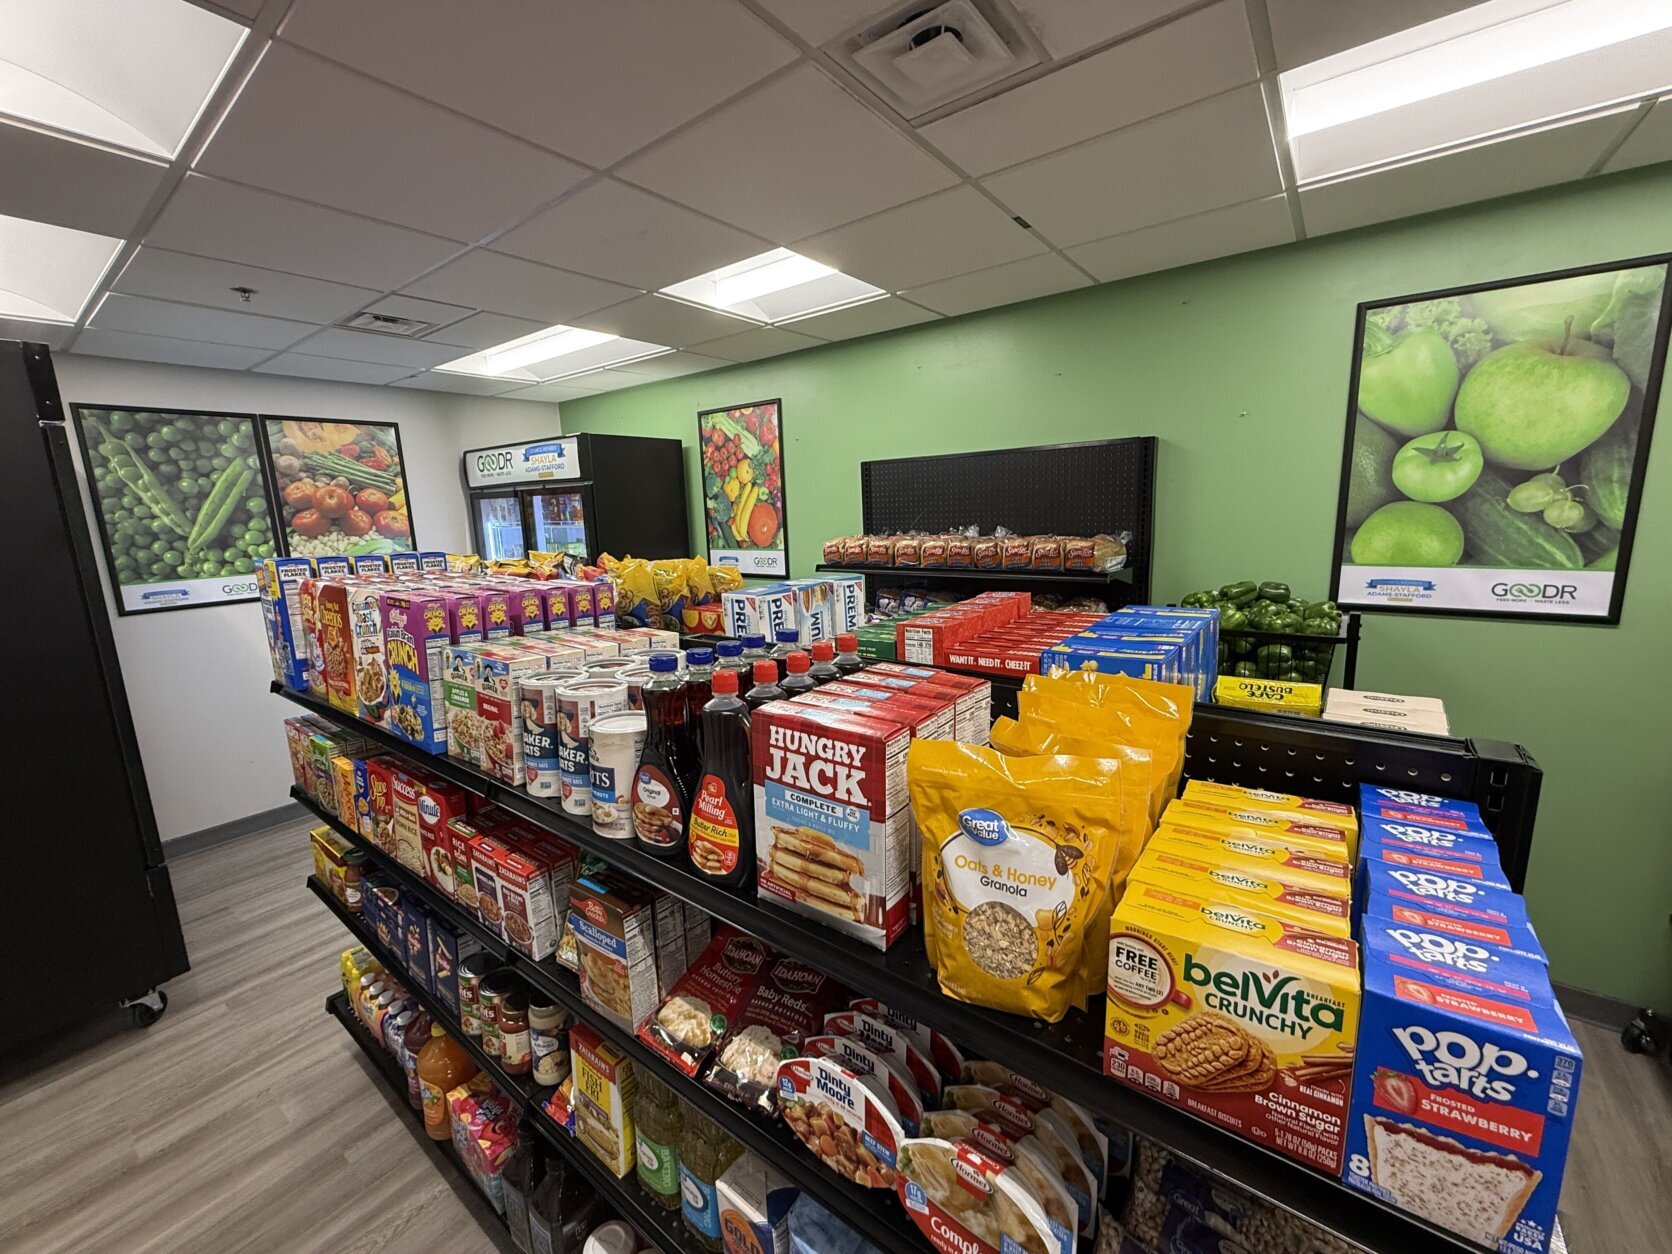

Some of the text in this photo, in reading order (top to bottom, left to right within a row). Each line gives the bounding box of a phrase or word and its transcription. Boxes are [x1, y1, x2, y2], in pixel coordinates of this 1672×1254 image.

[525, 463, 564, 473] ADAMS-STAFFORD
[530, 454, 557, 466] SHAYLA
[222, 582, 258, 594] GOOD
[1368, 591, 1432, 599] ADAMS-STAFFORD
[1492, 582, 1577, 600] GOODR
[354, 624, 378, 637] Crunch
[734, 600, 748, 639] PRE
[388, 640, 419, 674] CRUNCH
[950, 654, 968, 664] WANT
[978, 658, 994, 667] NEED
[1005, 659, 1031, 671] CHEEZ-IT
[1238, 683, 1292, 694] BUSTELO
[769, 725, 866, 766] HUNGRY
[392, 774, 416, 799] Success
[766, 746, 869, 806] JACK
[643, 786, 661, 796] Original
[701, 790, 723, 806] Pearl
[419, 800, 439, 817] Minute
[698, 799, 726, 820] Milling
[790, 793, 837, 814] COMPLETE
[772, 797, 860, 833] EXTRA LIGHT & FLUFFY
[961, 815, 1000, 831] Great
[694, 817, 728, 838] Butter Rich
[970, 828, 1000, 840] Value
[452, 837, 465, 851] RICE
[954, 854, 1057, 891] Oats & Honey
[980, 875, 1028, 897] Granola
[1200, 907, 1266, 930] belVita
[1209, 915, 1254, 930] CRUNCHY
[579, 920, 616, 948] Scalloped
[1153, 936, 1168, 951] START
[724, 945, 762, 964] IDAHOAN
[1116, 946, 1158, 971] FREE
[1408, 946, 1487, 972] tarts
[700, 966, 742, 994] Homestyle
[712, 963, 743, 985] Buttery
[774, 966, 821, 984] IDAHOAN
[1115, 960, 1157, 980] COFFEE
[757, 985, 807, 1012] Baby Reds
[1306, 991, 1346, 1009] BREAKFAST
[1436, 996, 1523, 1023] STRAWBERRY
[1205, 992, 1313, 1040] CRUNCHY
[862, 1020, 893, 1047] Dinty
[843, 1043, 875, 1072] Dinty
[582, 1066, 602, 1093] FISH
[782, 1078, 792, 1089] 12g
[818, 1067, 851, 1097] Dinty
[1014, 1075, 1044, 1098] Hormel
[1415, 1058, 1516, 1101] tarts
[586, 1081, 599, 1101] FRI
[816, 1077, 854, 1109] Moore
[1300, 1085, 1344, 1106] REAL CINNAMON
[997, 1102, 1029, 1126] Hormel
[1187, 1098, 1242, 1128] BREAKFAST BISCUITS
[1254, 1094, 1340, 1134] Brown Sugar
[1269, 1092, 1341, 1126] Cinnamon
[1430, 1093, 1475, 1113] FROSTED
[1266, 1113, 1338, 1146] Other Natural Flavor
[1272, 1111, 1340, 1141] Natural Flavor with
[1421, 1099, 1532, 1143] STRAWBERRY
[877, 1142, 890, 1155] STEW
[976, 1130, 1012, 1157] Hormel
[1318, 1146, 1338, 1160] PACKS
[1317, 1154, 1337, 1168] (250g)
[1349, 1154, 1370, 1177] 8
[955, 1162, 988, 1189] Hormel
[1513, 1232, 1542, 1251] USA
